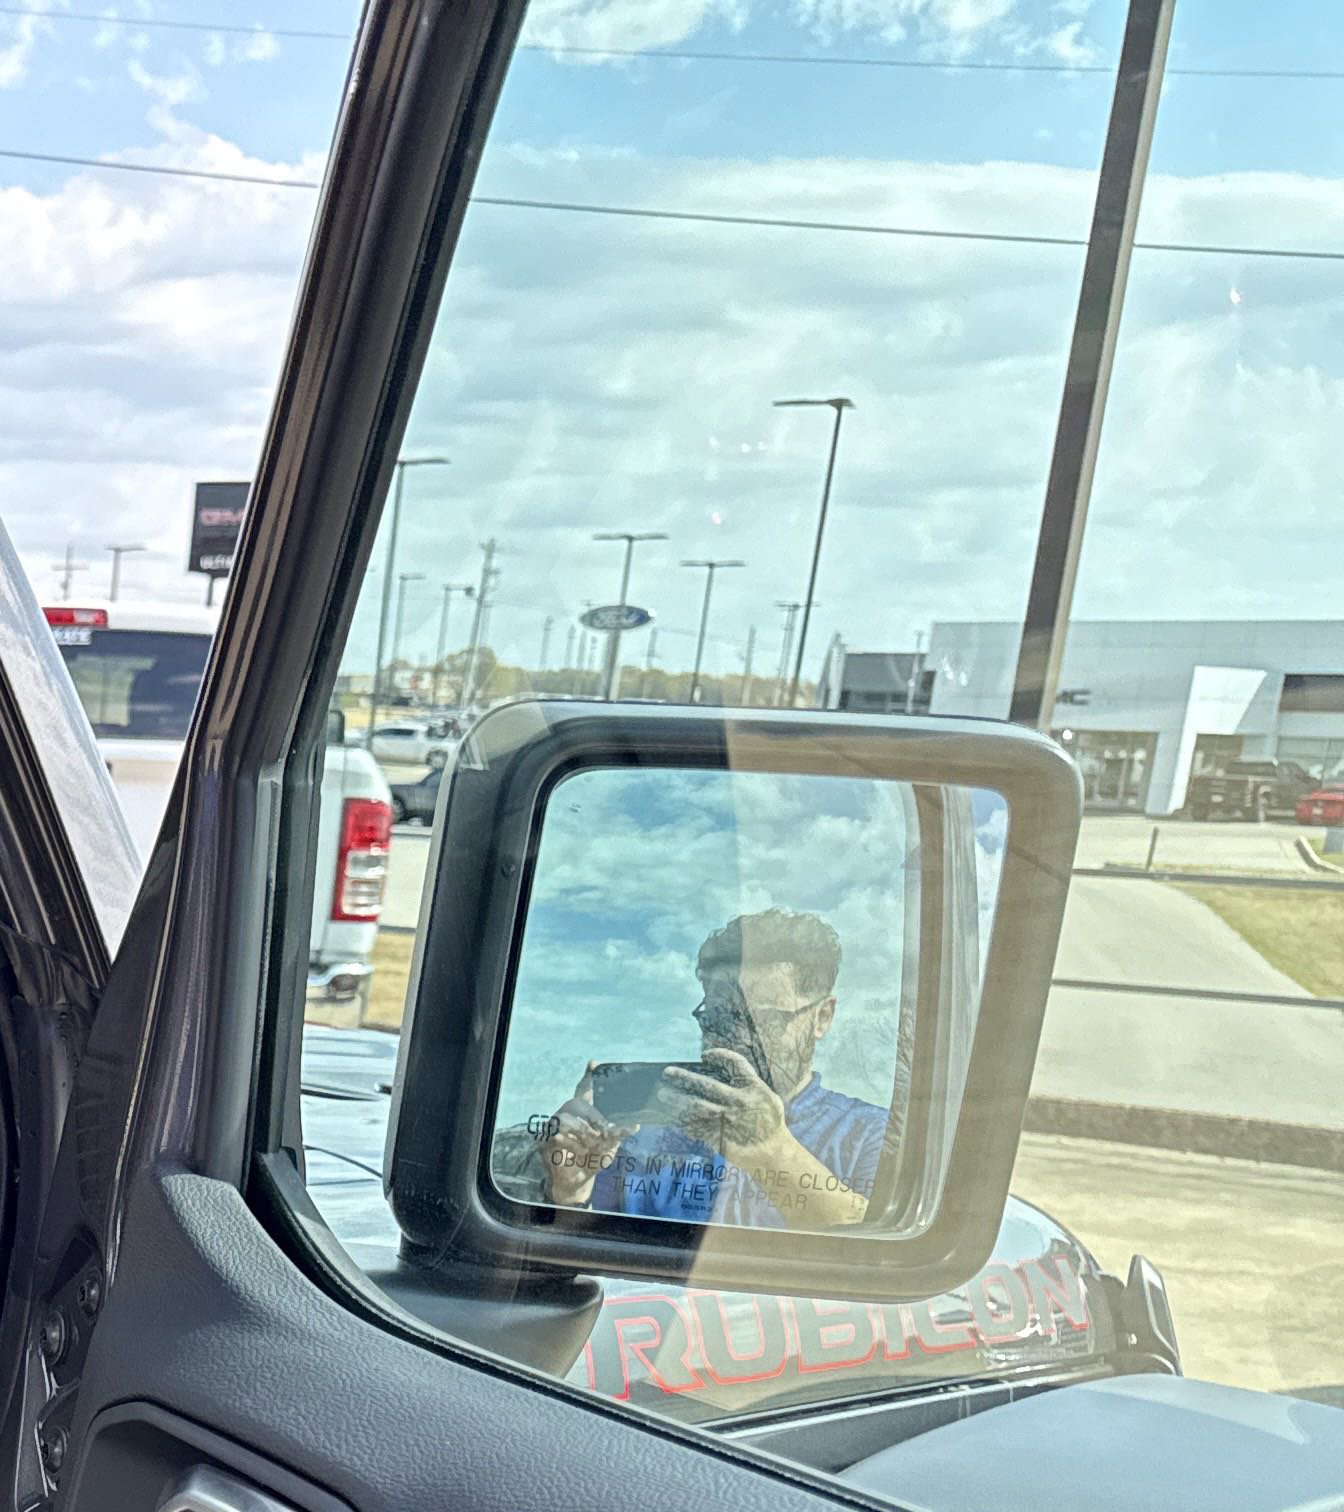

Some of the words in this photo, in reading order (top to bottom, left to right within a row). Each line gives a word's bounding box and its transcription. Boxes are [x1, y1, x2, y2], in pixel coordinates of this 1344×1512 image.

[550, 1150, 636, 1171] OBJECTS
[645, 1156, 662, 1173] IN
[670, 1159, 739, 1182] MIRROR
[752, 1169, 790, 1188] ARE
[612, 1175, 660, 1197] THAN
[671, 1181, 719, 1202] THEY
[732, 1189, 808, 1210] APPEAR
[584, 1254, 1090, 1401] RUBICON
